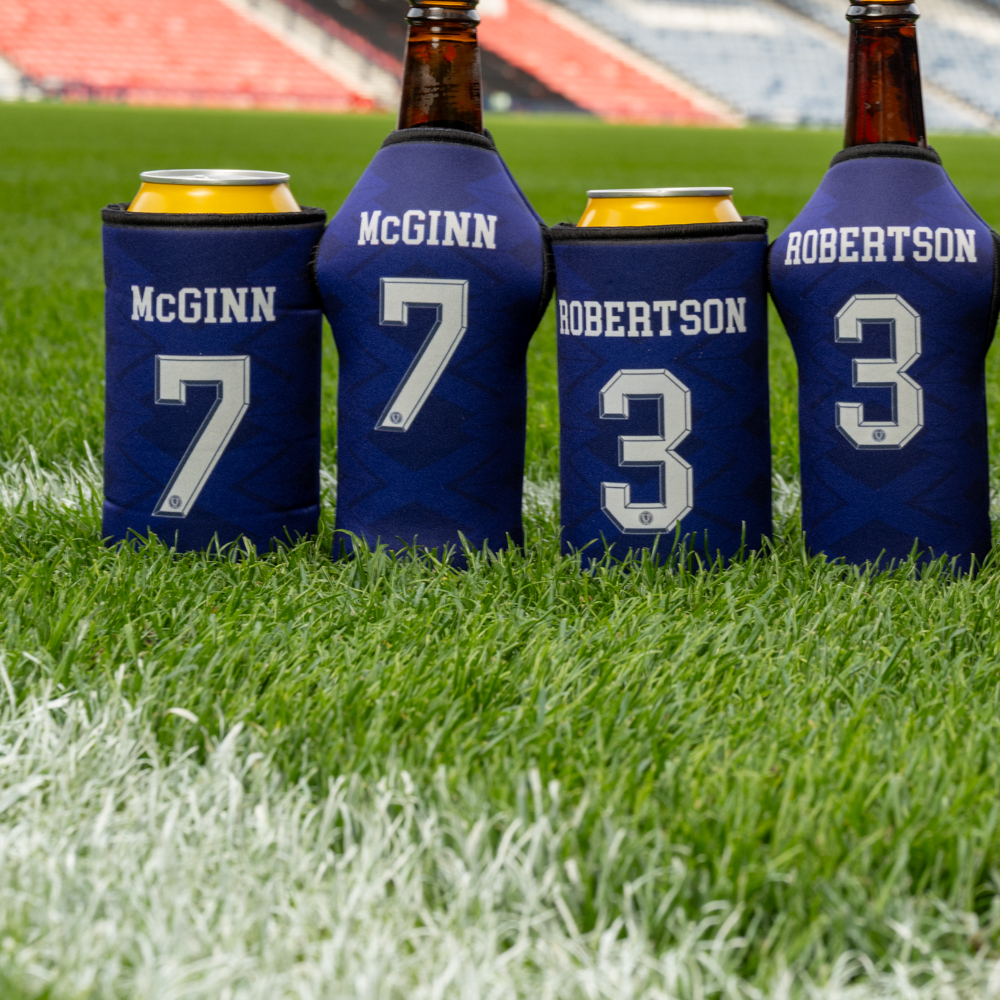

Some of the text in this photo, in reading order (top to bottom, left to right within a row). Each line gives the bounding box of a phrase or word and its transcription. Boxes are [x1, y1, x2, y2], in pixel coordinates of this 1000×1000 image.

[357, 209, 498, 249] McGINN
[784, 226, 977, 265] ROBERTSON
[130, 285, 276, 324] McGINN
[559, 297, 747, 338] ROBERTSON
[373, 277, 469, 432] 7
[833, 293, 925, 451] 3
[151, 354, 251, 519] 7
[599, 368, 694, 535] 3
